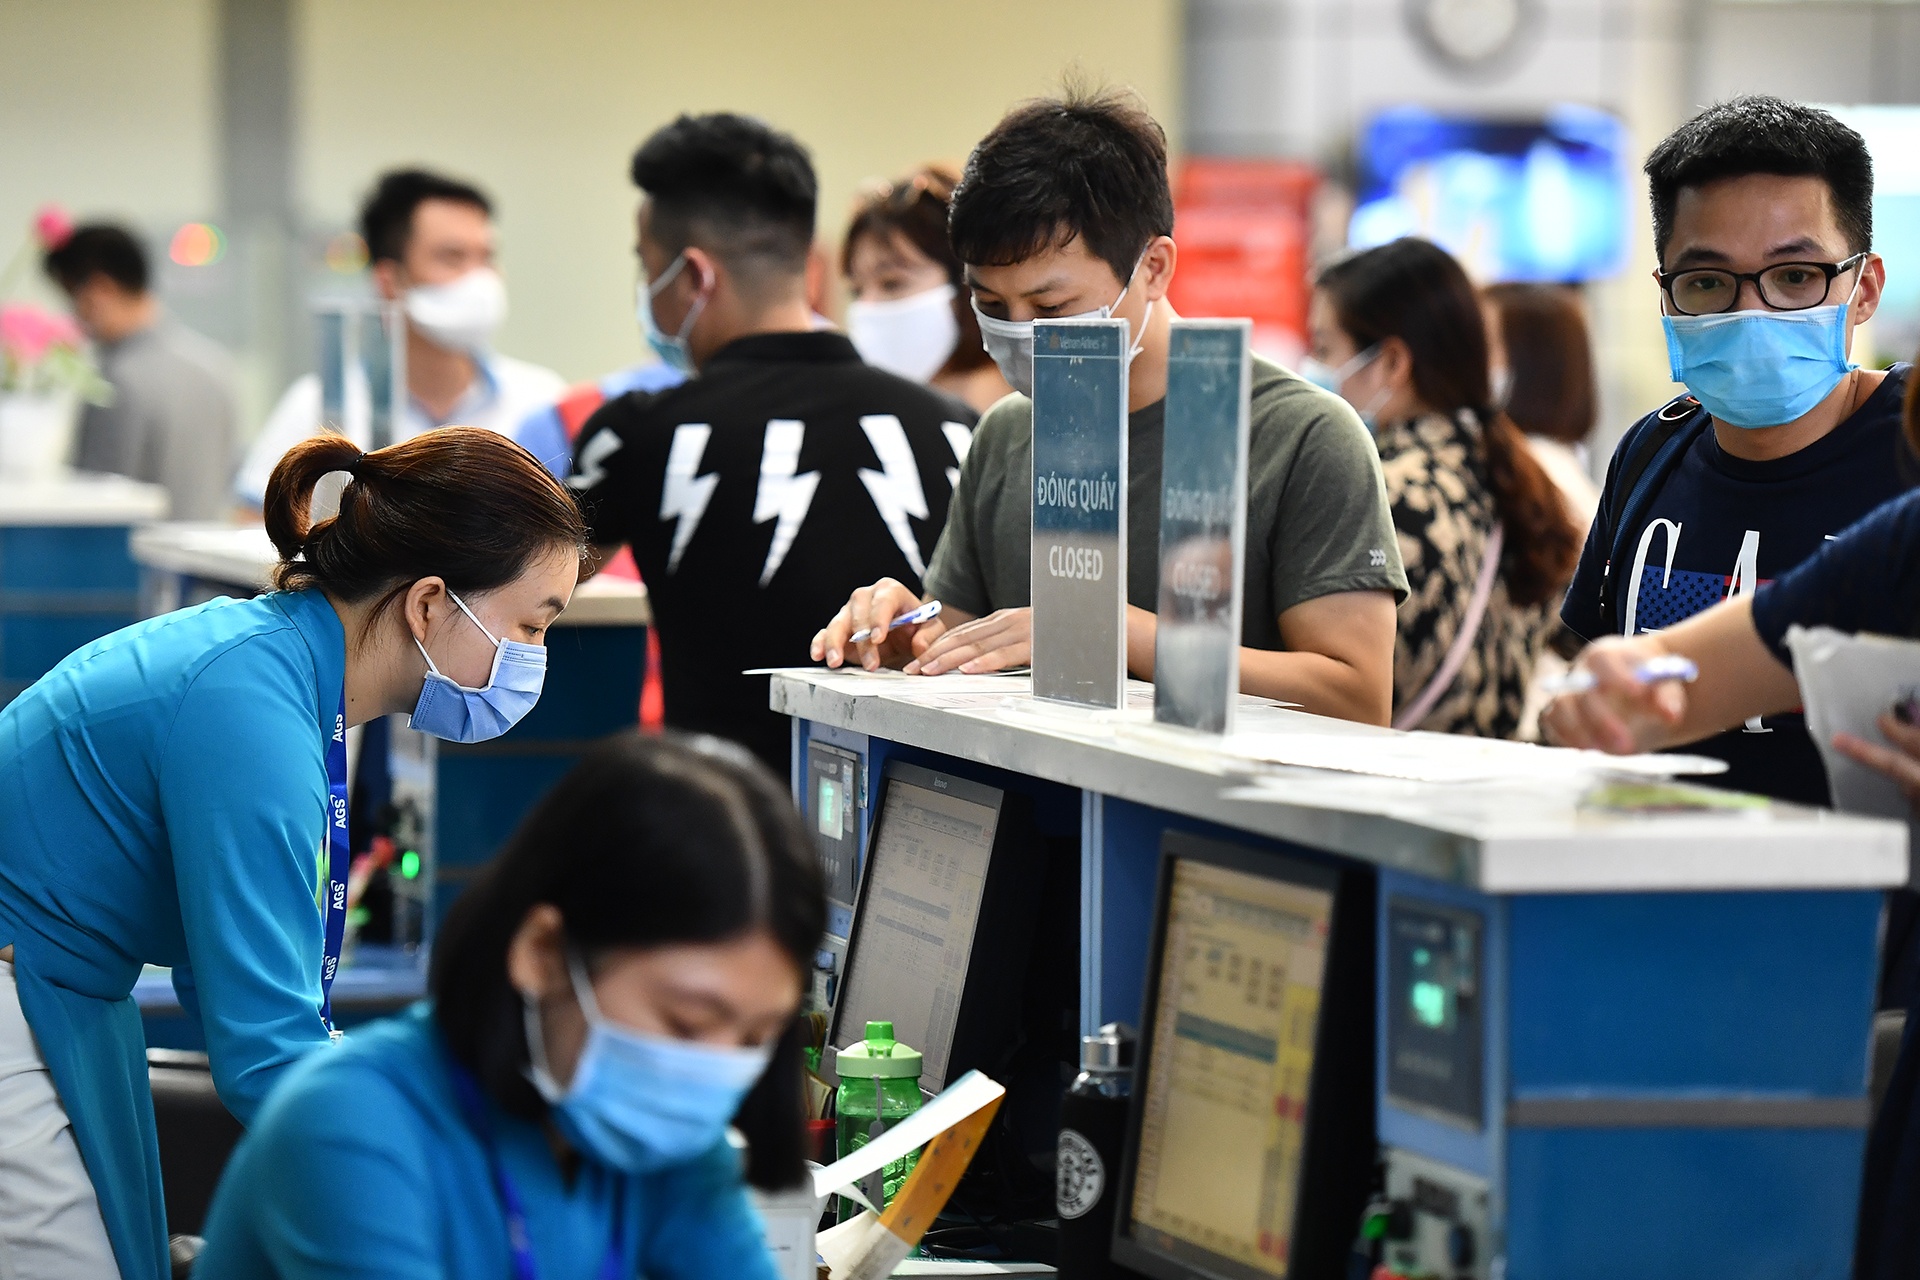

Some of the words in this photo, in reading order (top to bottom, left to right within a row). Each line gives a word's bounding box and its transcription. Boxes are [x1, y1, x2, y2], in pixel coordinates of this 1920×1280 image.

[1038, 471, 1077, 508] ĐÓNG
[1049, 545, 1103, 581] CLOSED
[334, 798, 347, 829] AGS
[333, 882, 346, 911] AGS
[324, 956, 338, 980] AGS
